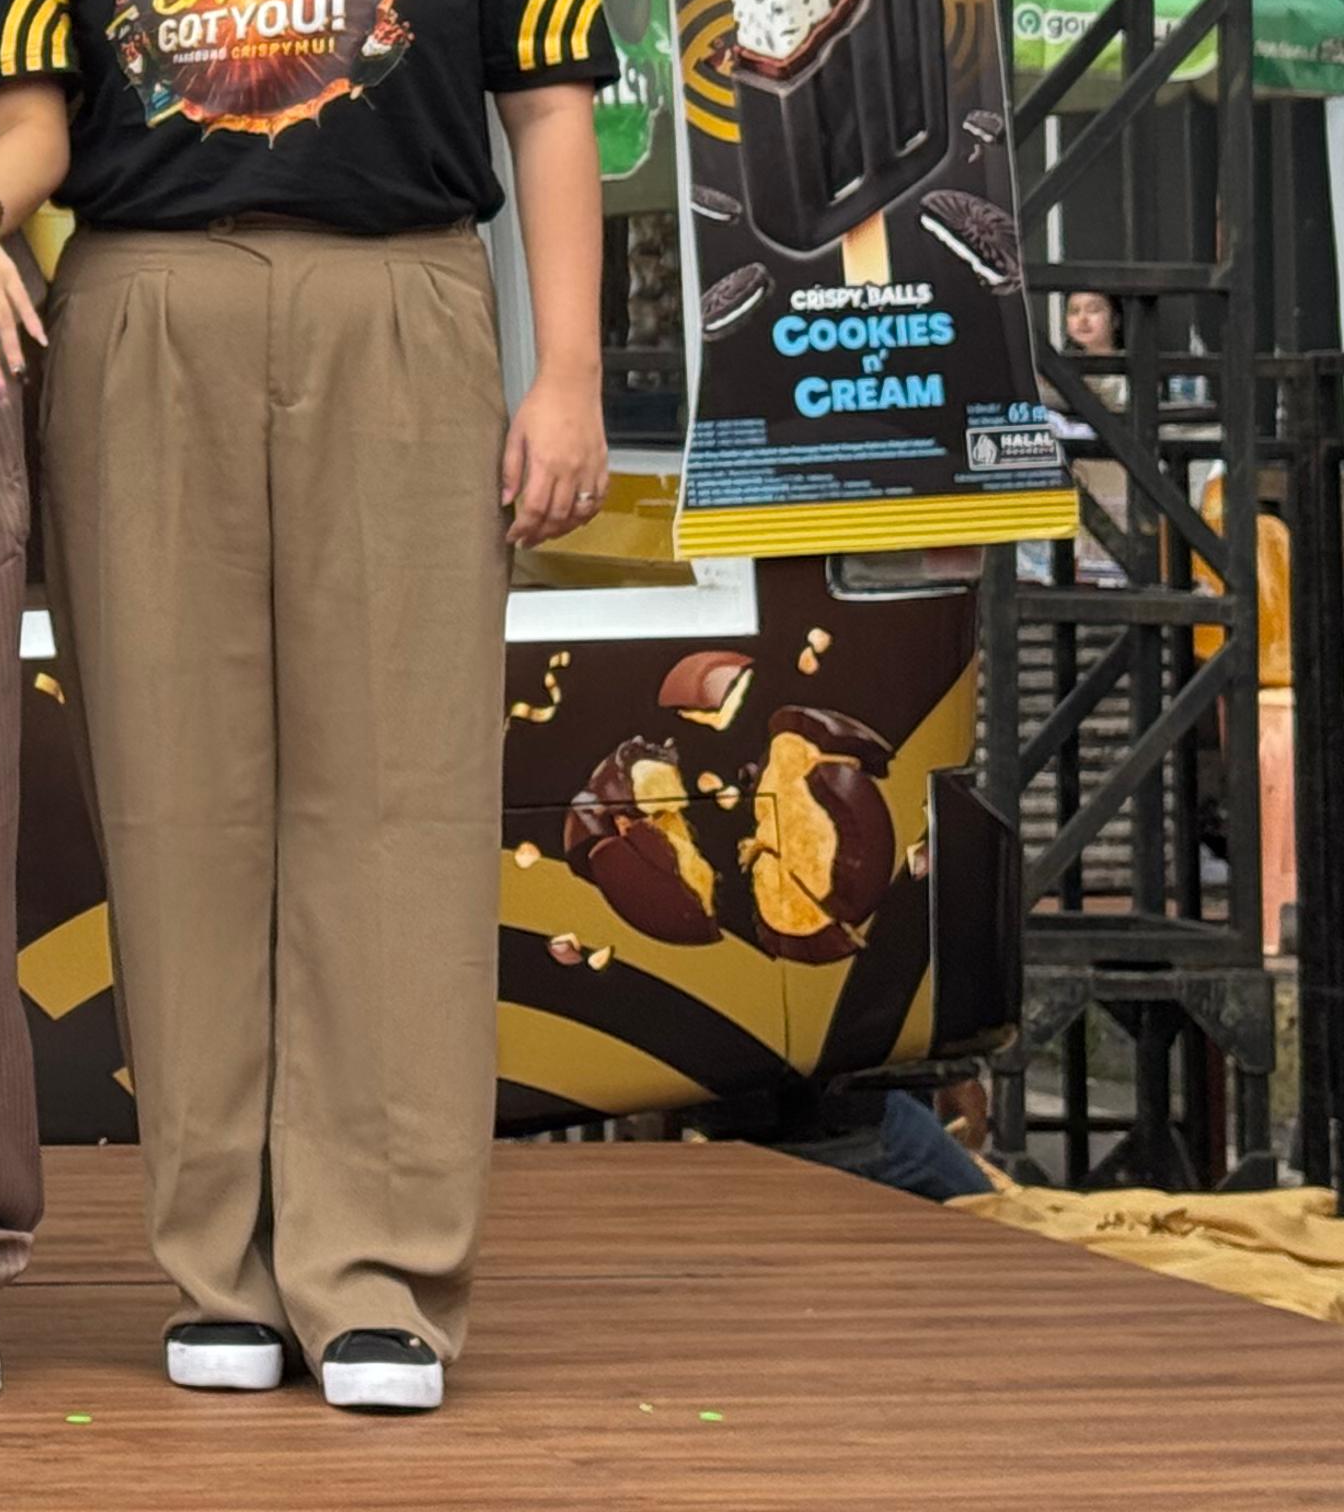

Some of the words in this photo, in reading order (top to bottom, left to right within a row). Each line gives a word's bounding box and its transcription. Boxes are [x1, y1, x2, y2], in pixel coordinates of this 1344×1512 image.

[790, 285, 863, 311] CRISPY
[867, 282, 933, 308] BALLS
[773, 312, 956, 357] COOKIES
[794, 374, 946, 419] CREAM
[1000, 431, 1055, 448] HALAL
